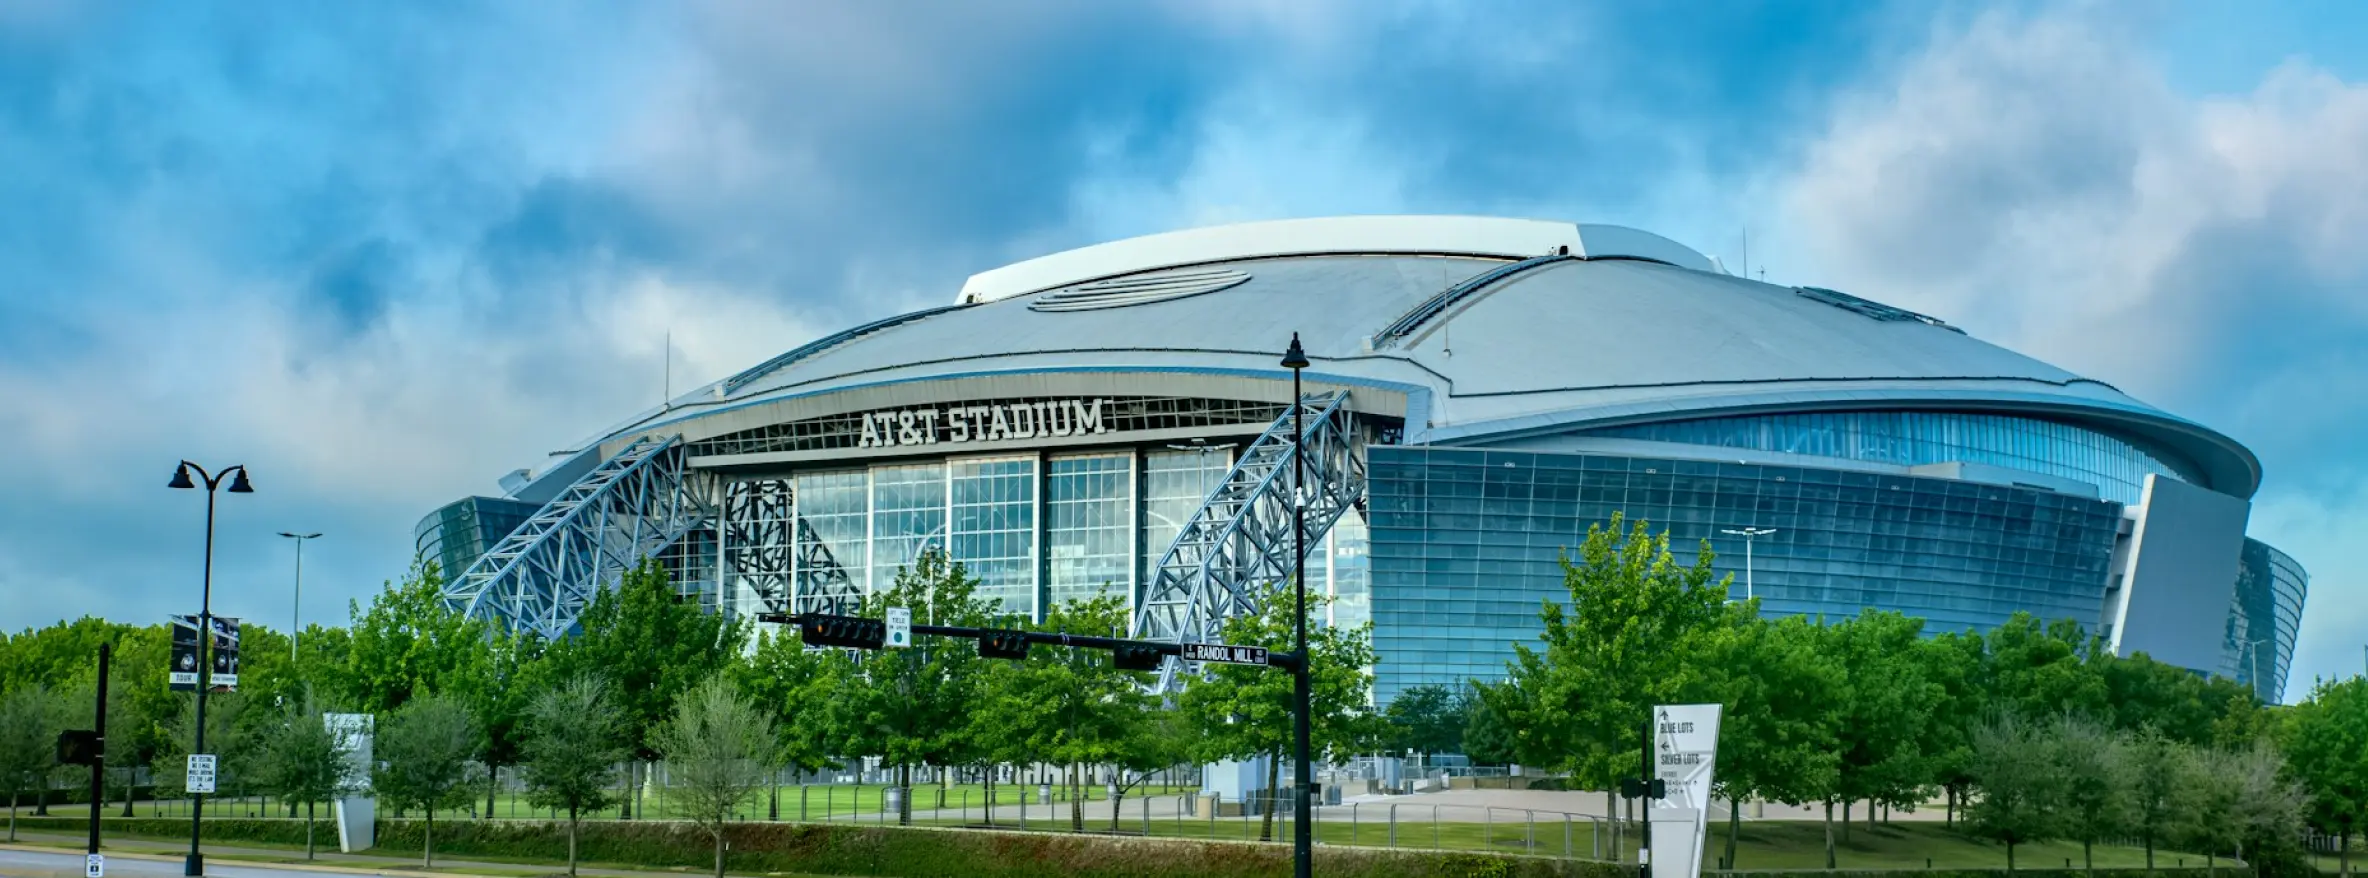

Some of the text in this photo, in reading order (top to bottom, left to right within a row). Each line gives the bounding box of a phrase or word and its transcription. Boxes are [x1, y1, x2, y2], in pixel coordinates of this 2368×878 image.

[859, 399, 1105, 448] AT&T STADIUM
[1197, 645, 1231, 660] RANDOL
[1234, 648, 1253, 662] MILL
[1660, 722, 1694, 734] BLUE LOTS
[1660, 753, 1700, 765] SILVER LOTS
